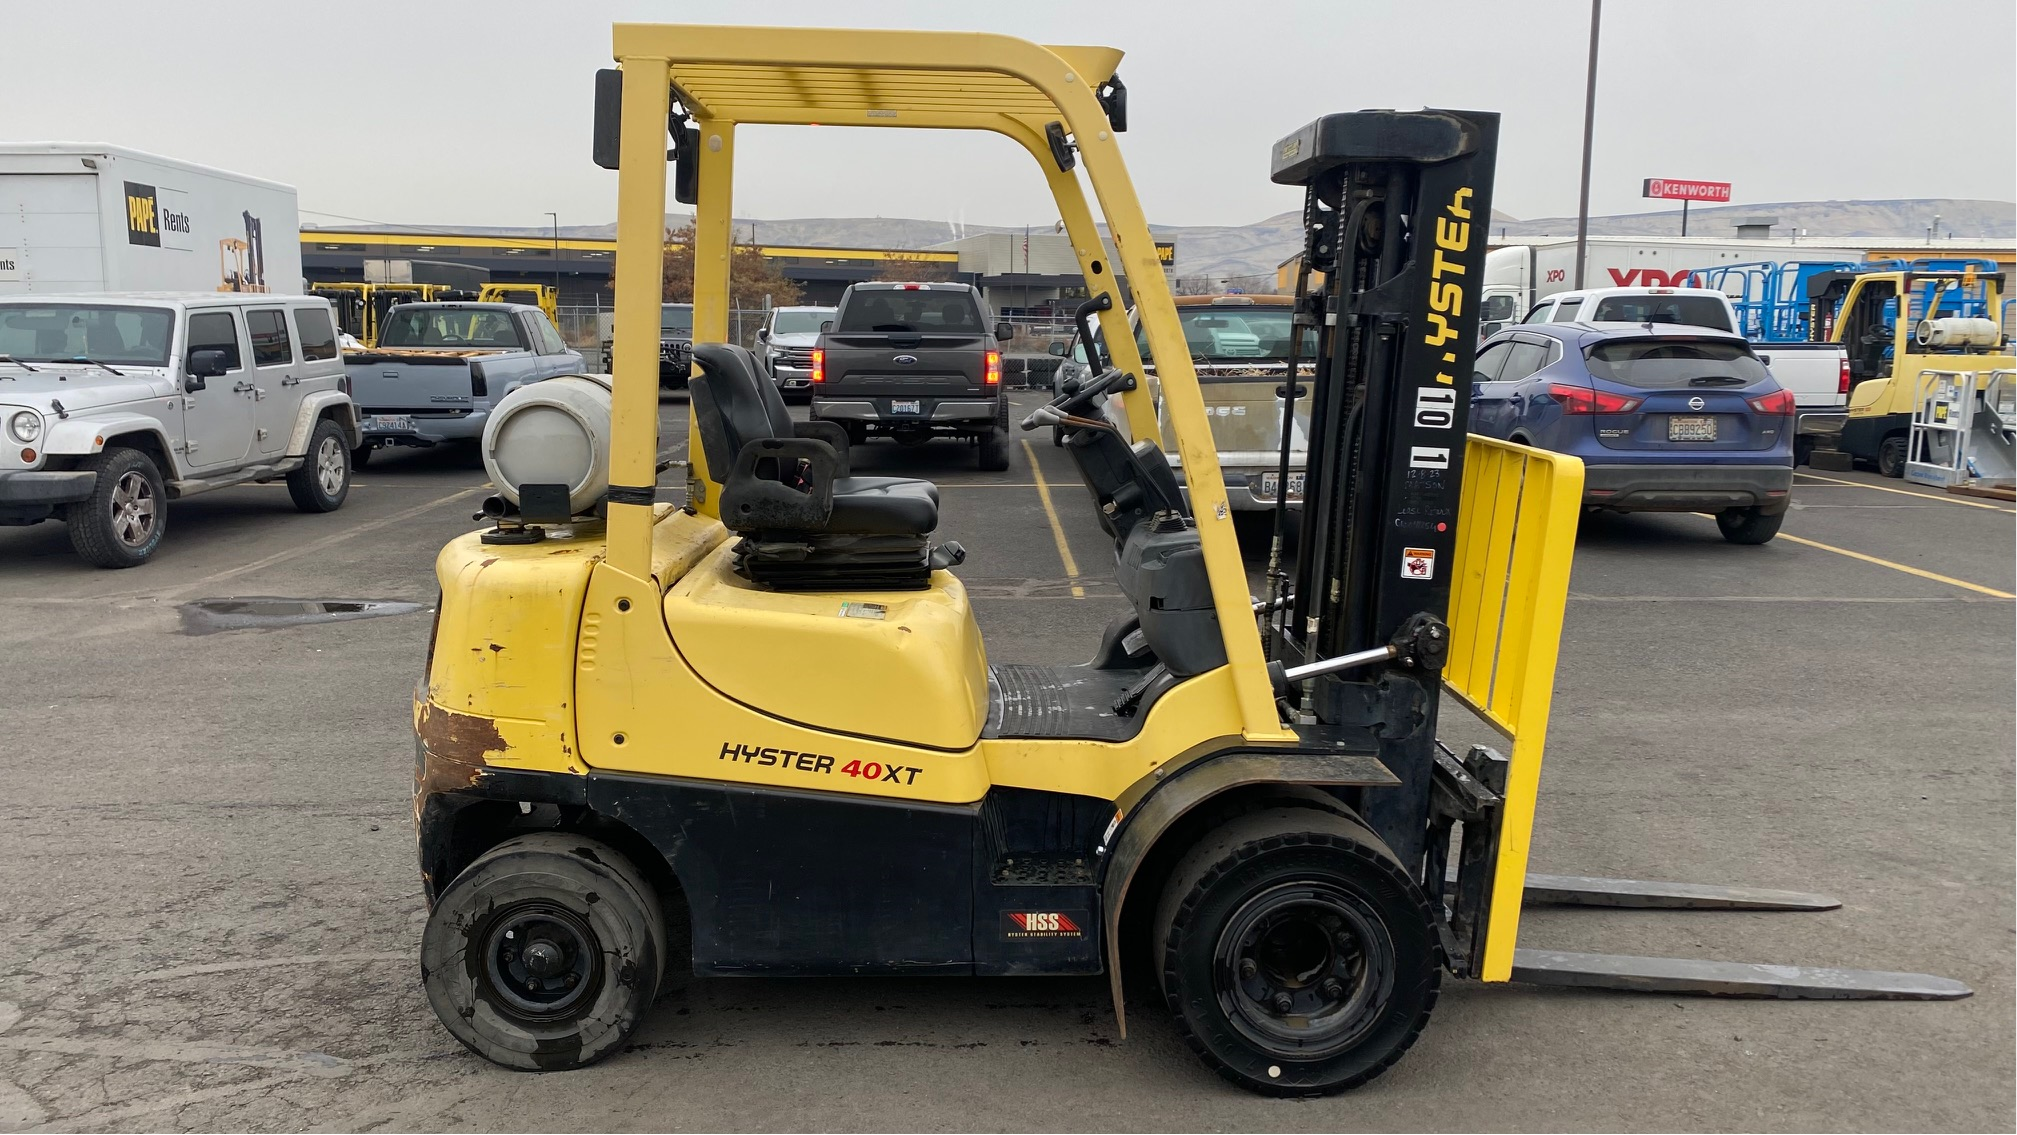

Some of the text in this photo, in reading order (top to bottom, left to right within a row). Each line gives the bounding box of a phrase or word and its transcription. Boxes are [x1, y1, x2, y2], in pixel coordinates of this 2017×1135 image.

[1663, 183, 1730, 198] KENWORTH
[163, 208, 190, 234] Rents
[1546, 269, 1565, 283] XPO
[719, 742, 923, 785] HYSTER 40XT
[1026, 913, 1059, 931] HSS
